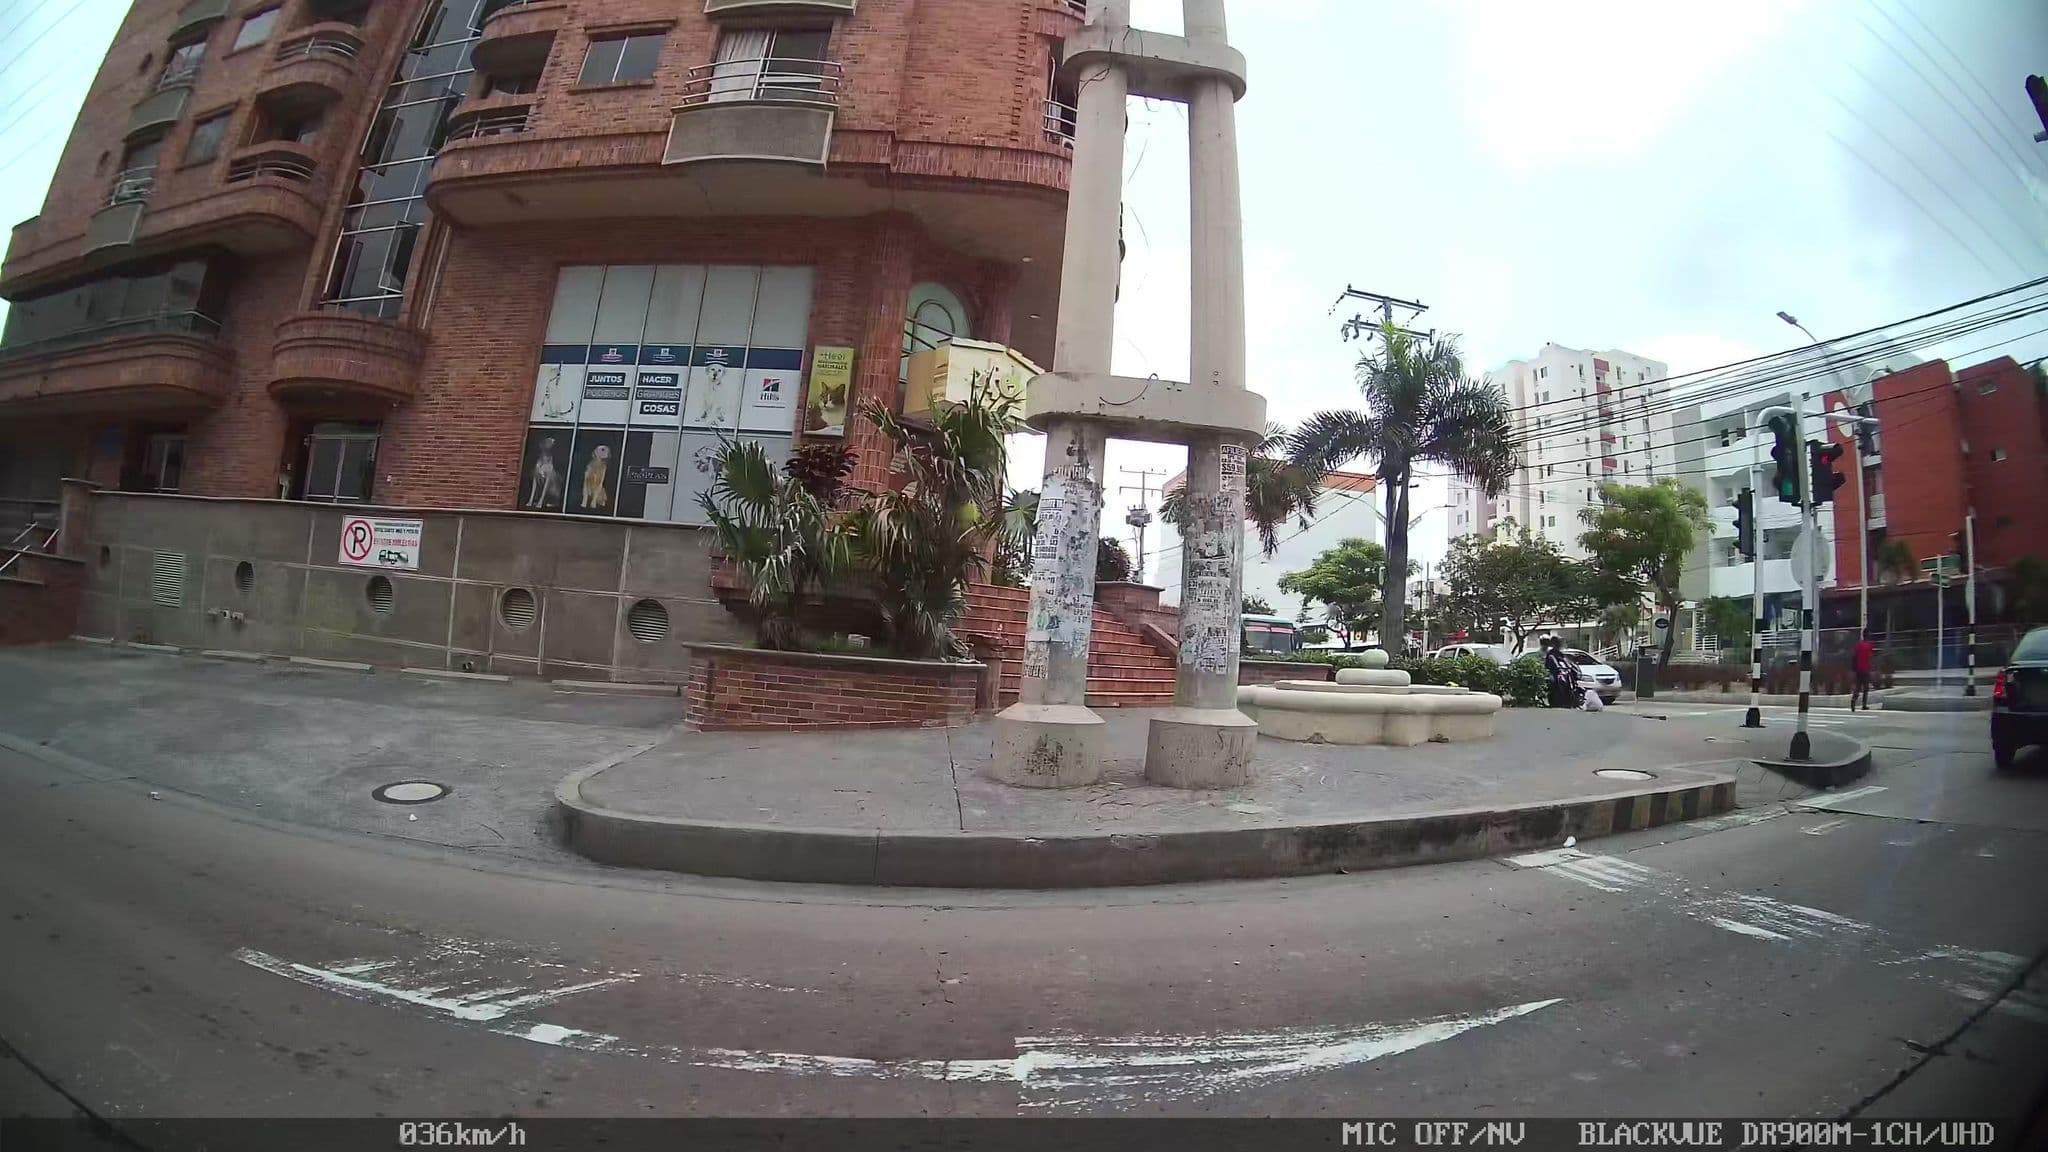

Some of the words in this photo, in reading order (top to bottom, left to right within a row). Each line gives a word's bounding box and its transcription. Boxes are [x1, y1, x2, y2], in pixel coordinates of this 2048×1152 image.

[589, 375, 623, 383] JUNTOS
[642, 376, 672, 384] HACER
[585, 387, 628, 399] PODEMOS
[637, 388, 680, 399] GRANDES
[643, 404, 676, 413] COSAS
